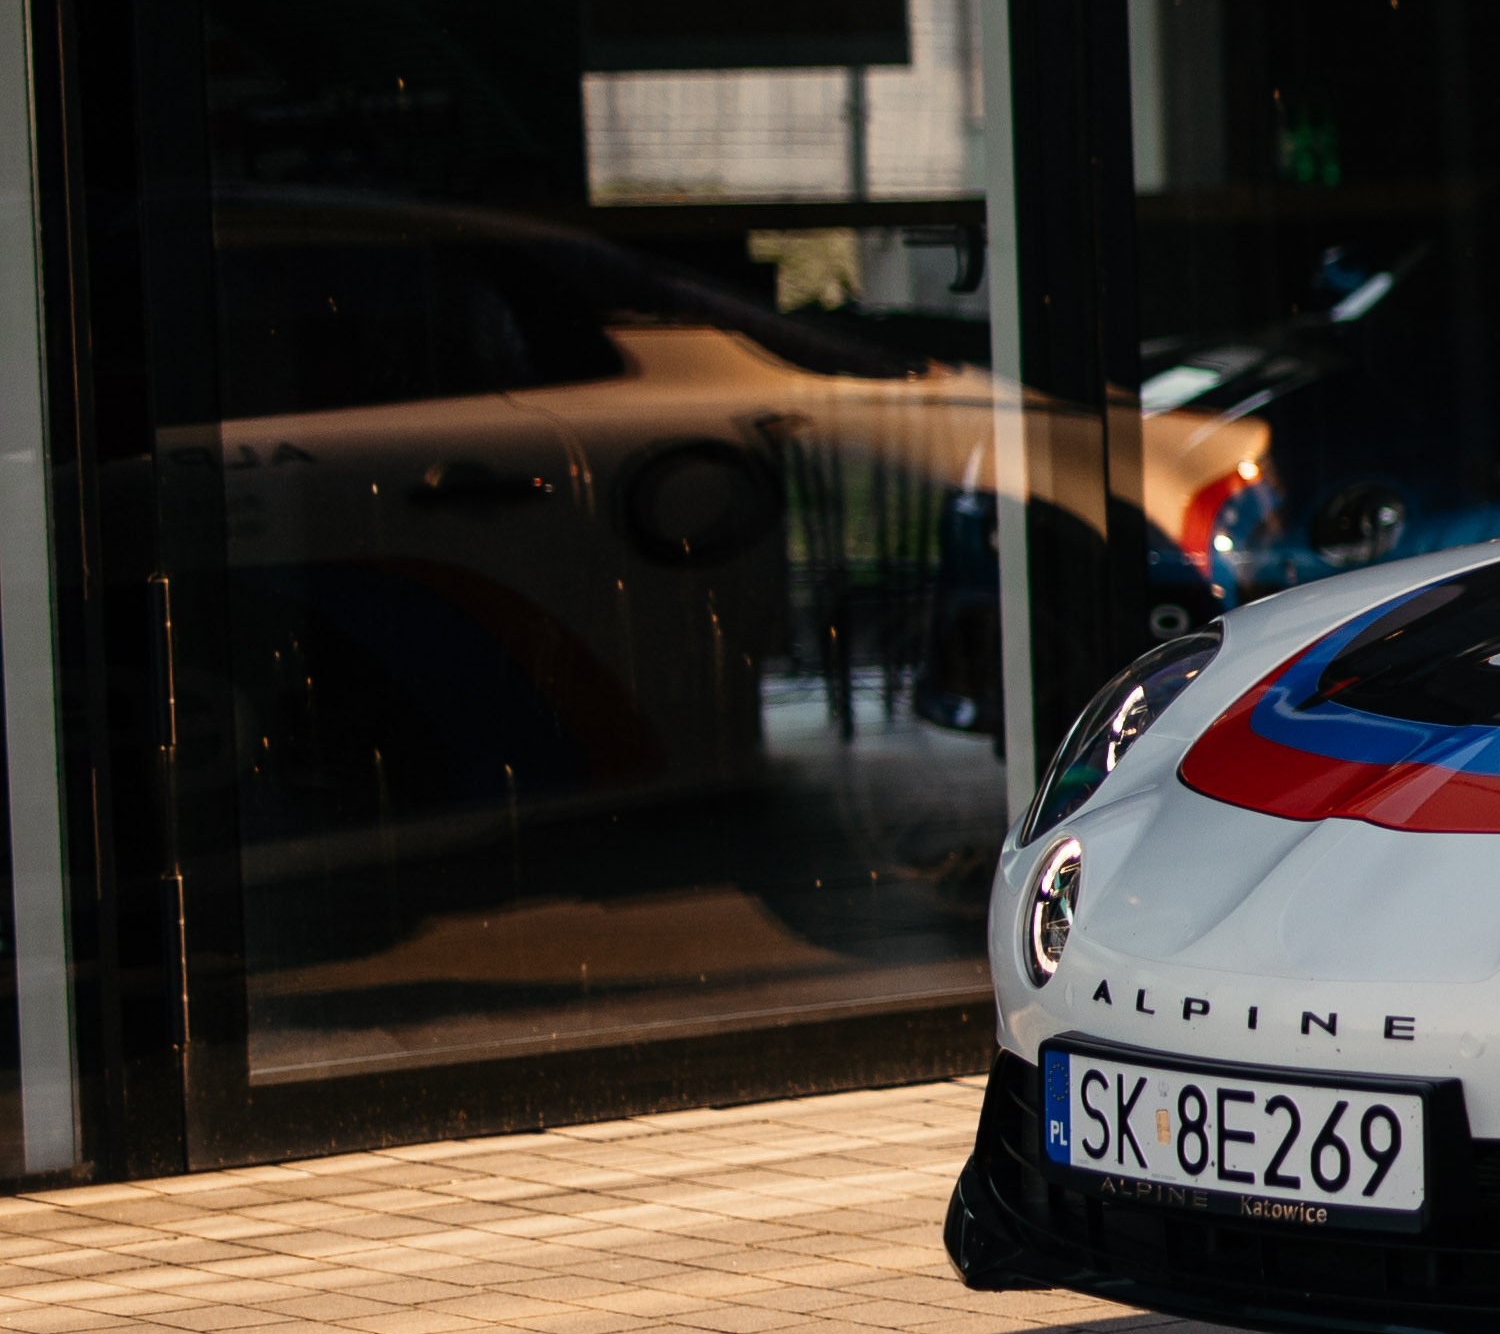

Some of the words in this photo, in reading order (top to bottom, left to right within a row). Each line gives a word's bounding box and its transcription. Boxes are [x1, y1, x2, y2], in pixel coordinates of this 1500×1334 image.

[1092, 978, 1416, 1042] ALPINE
[1050, 1119, 1068, 1147] PL
[1080, 1068, 1149, 1170] SK
[1176, 1083, 1403, 1198] 8E269
[1101, 1176, 1209, 1208] ALPINE
[1240, 1195, 1329, 1223] Katowice
